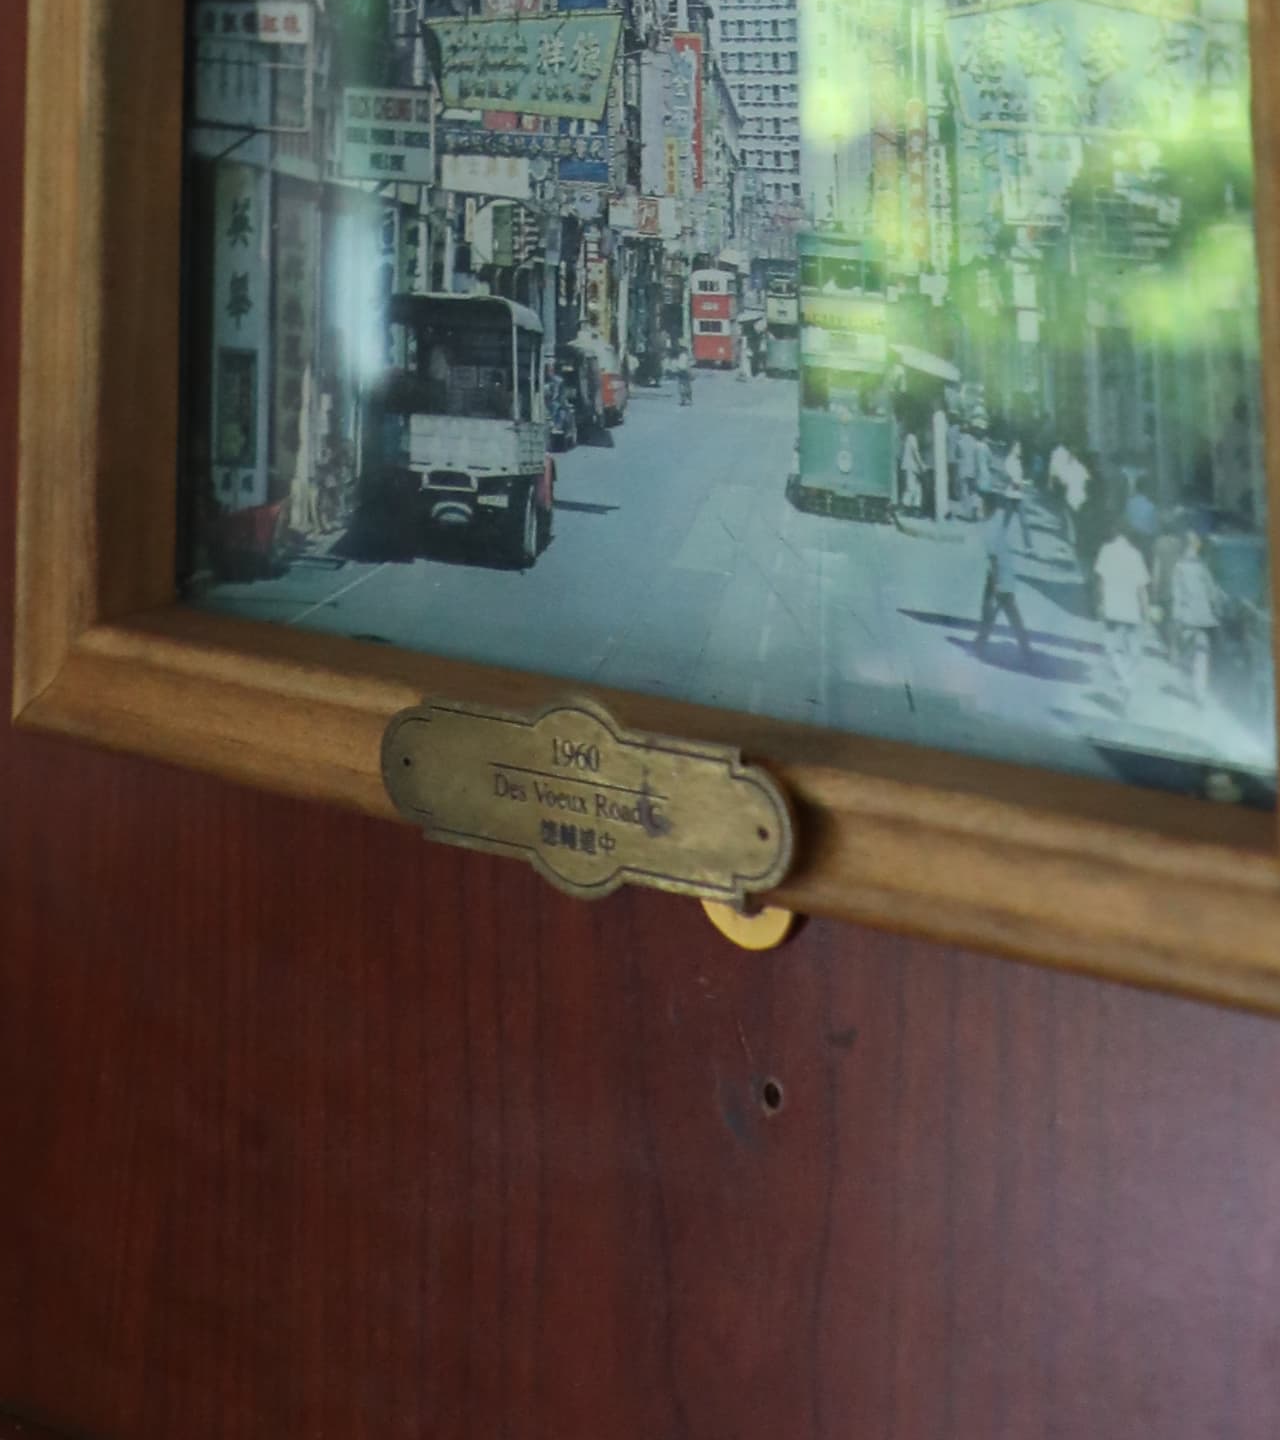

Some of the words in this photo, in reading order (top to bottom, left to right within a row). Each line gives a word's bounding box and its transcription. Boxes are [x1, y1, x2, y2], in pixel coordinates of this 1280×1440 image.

[552, 736, 601, 773] 1960
[493, 773, 527, 802] Des
[533, 781, 588, 815] Voeux
[594, 793, 642, 826] Road
